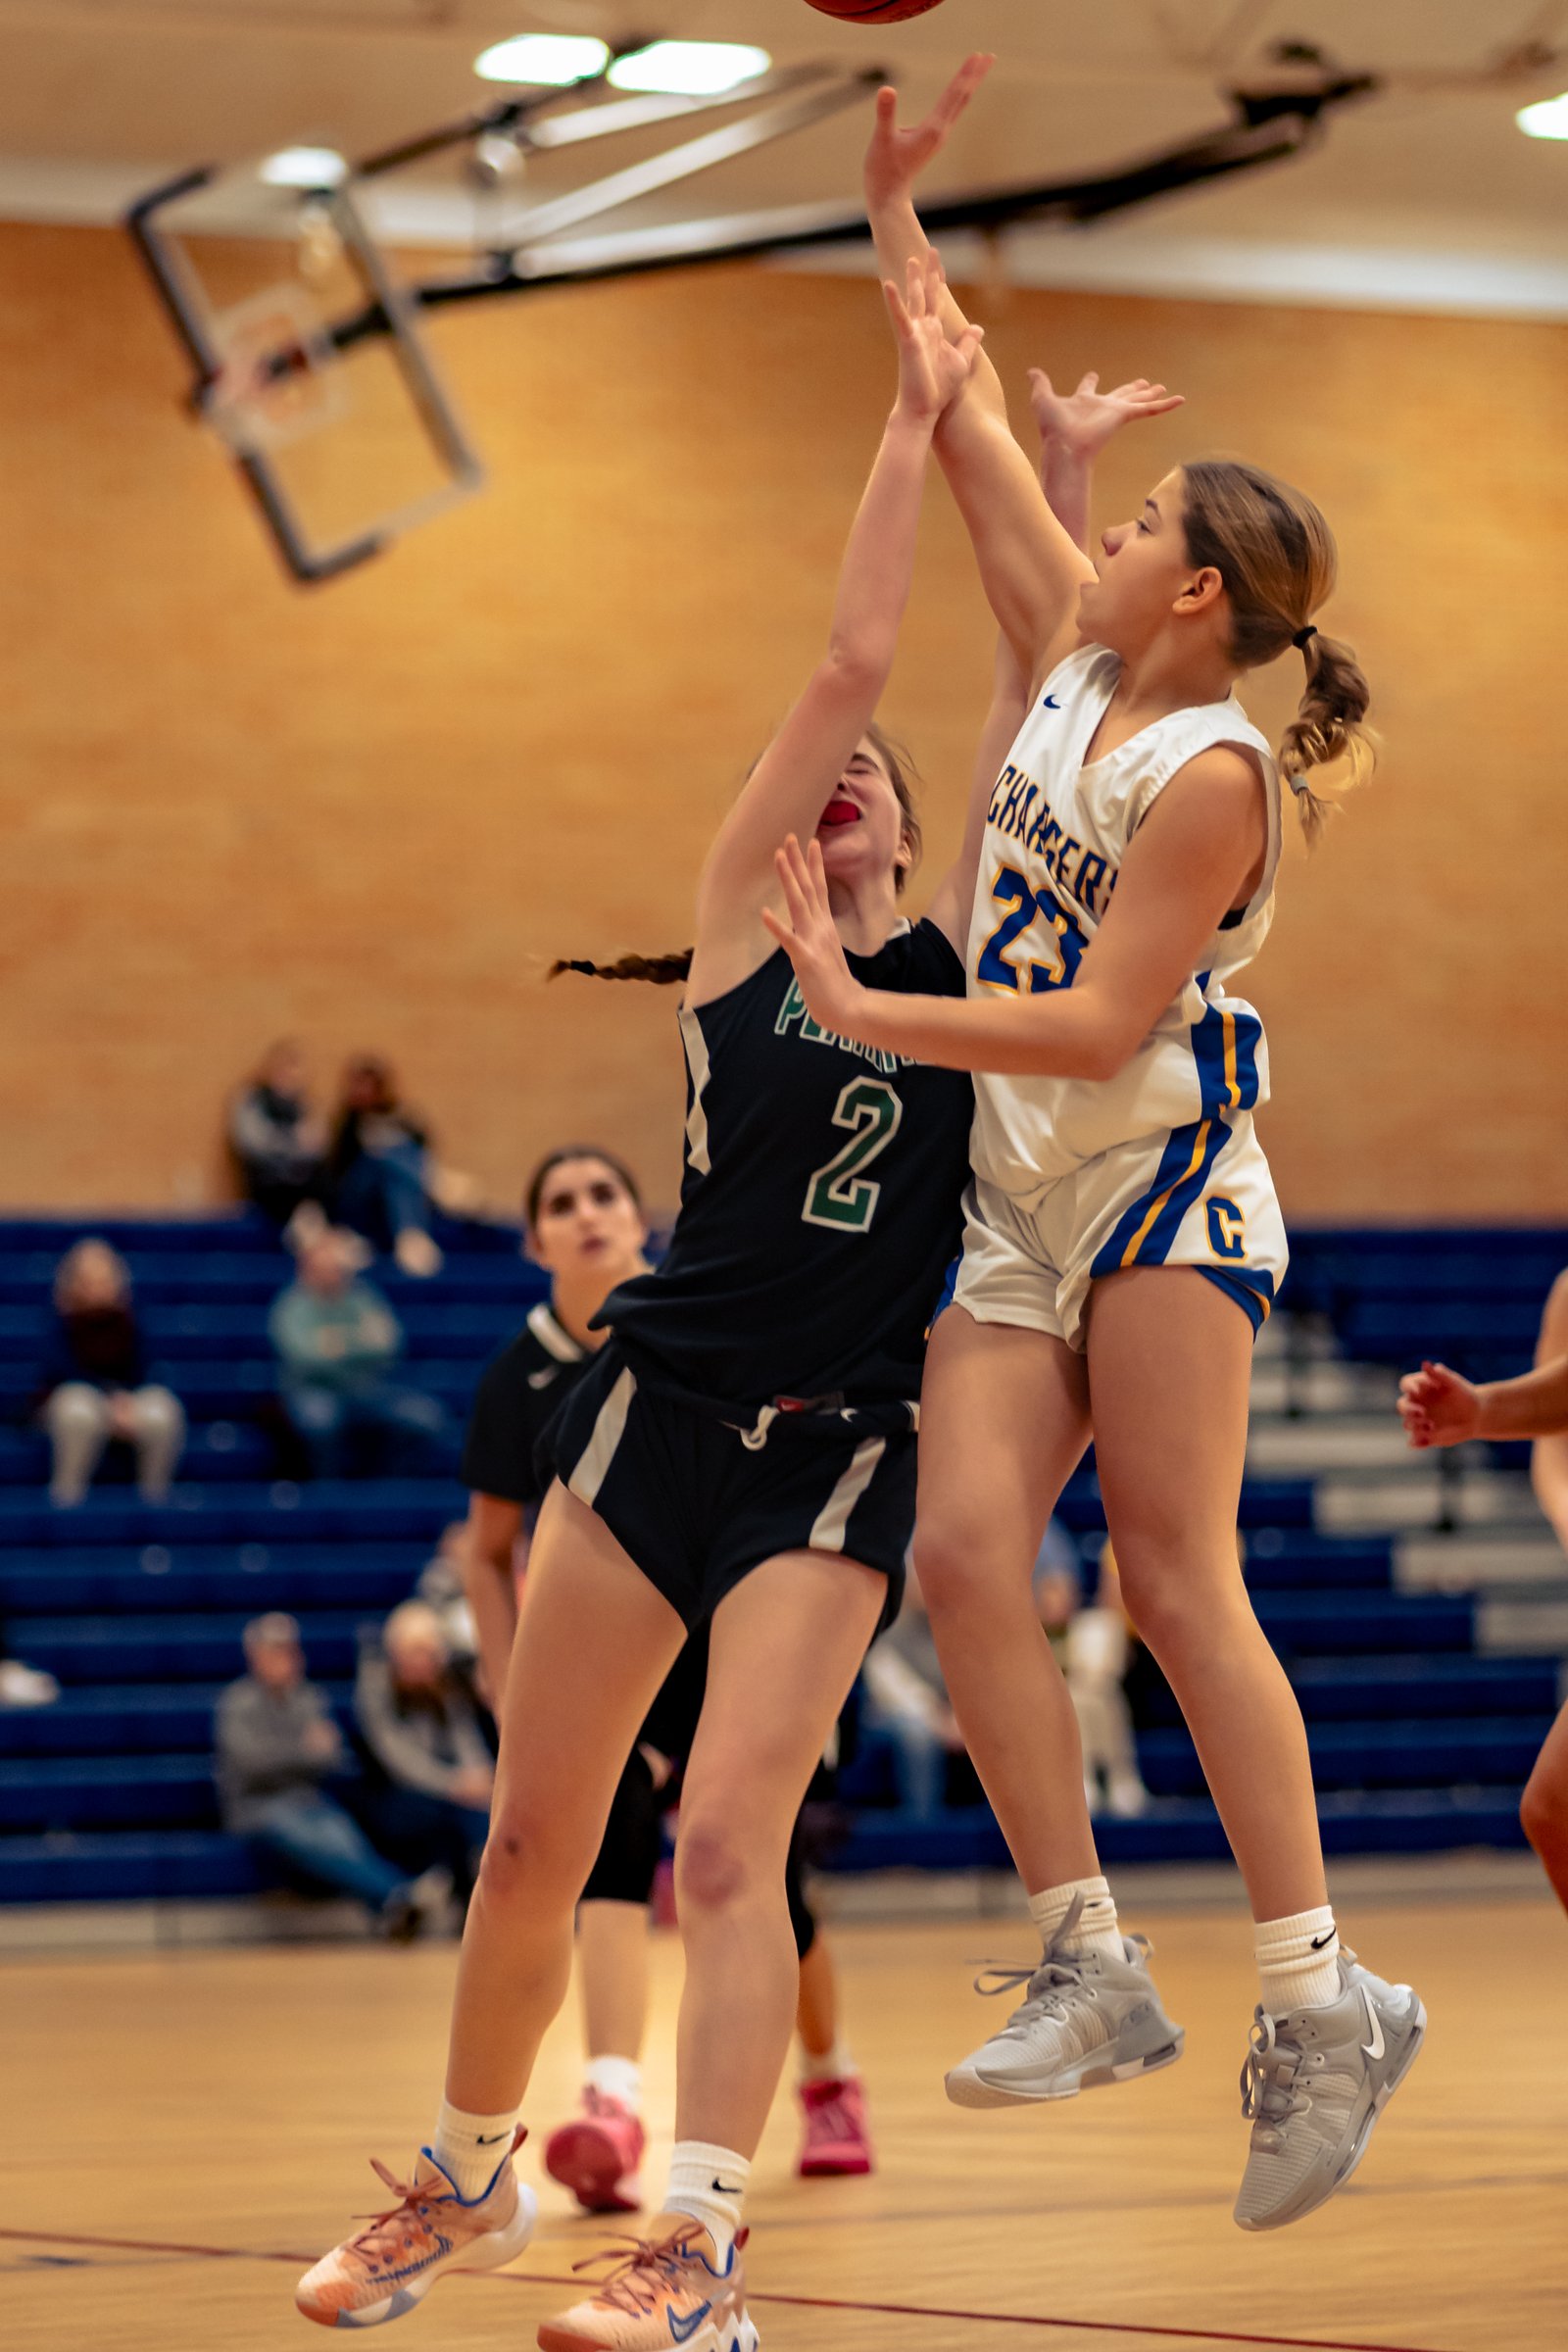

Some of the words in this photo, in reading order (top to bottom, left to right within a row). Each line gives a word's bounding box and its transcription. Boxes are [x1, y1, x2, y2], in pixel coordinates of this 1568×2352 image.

[976, 861, 1091, 996] 23
[801, 1075, 903, 1233] 2
[1201, 1194, 1250, 1264] C
